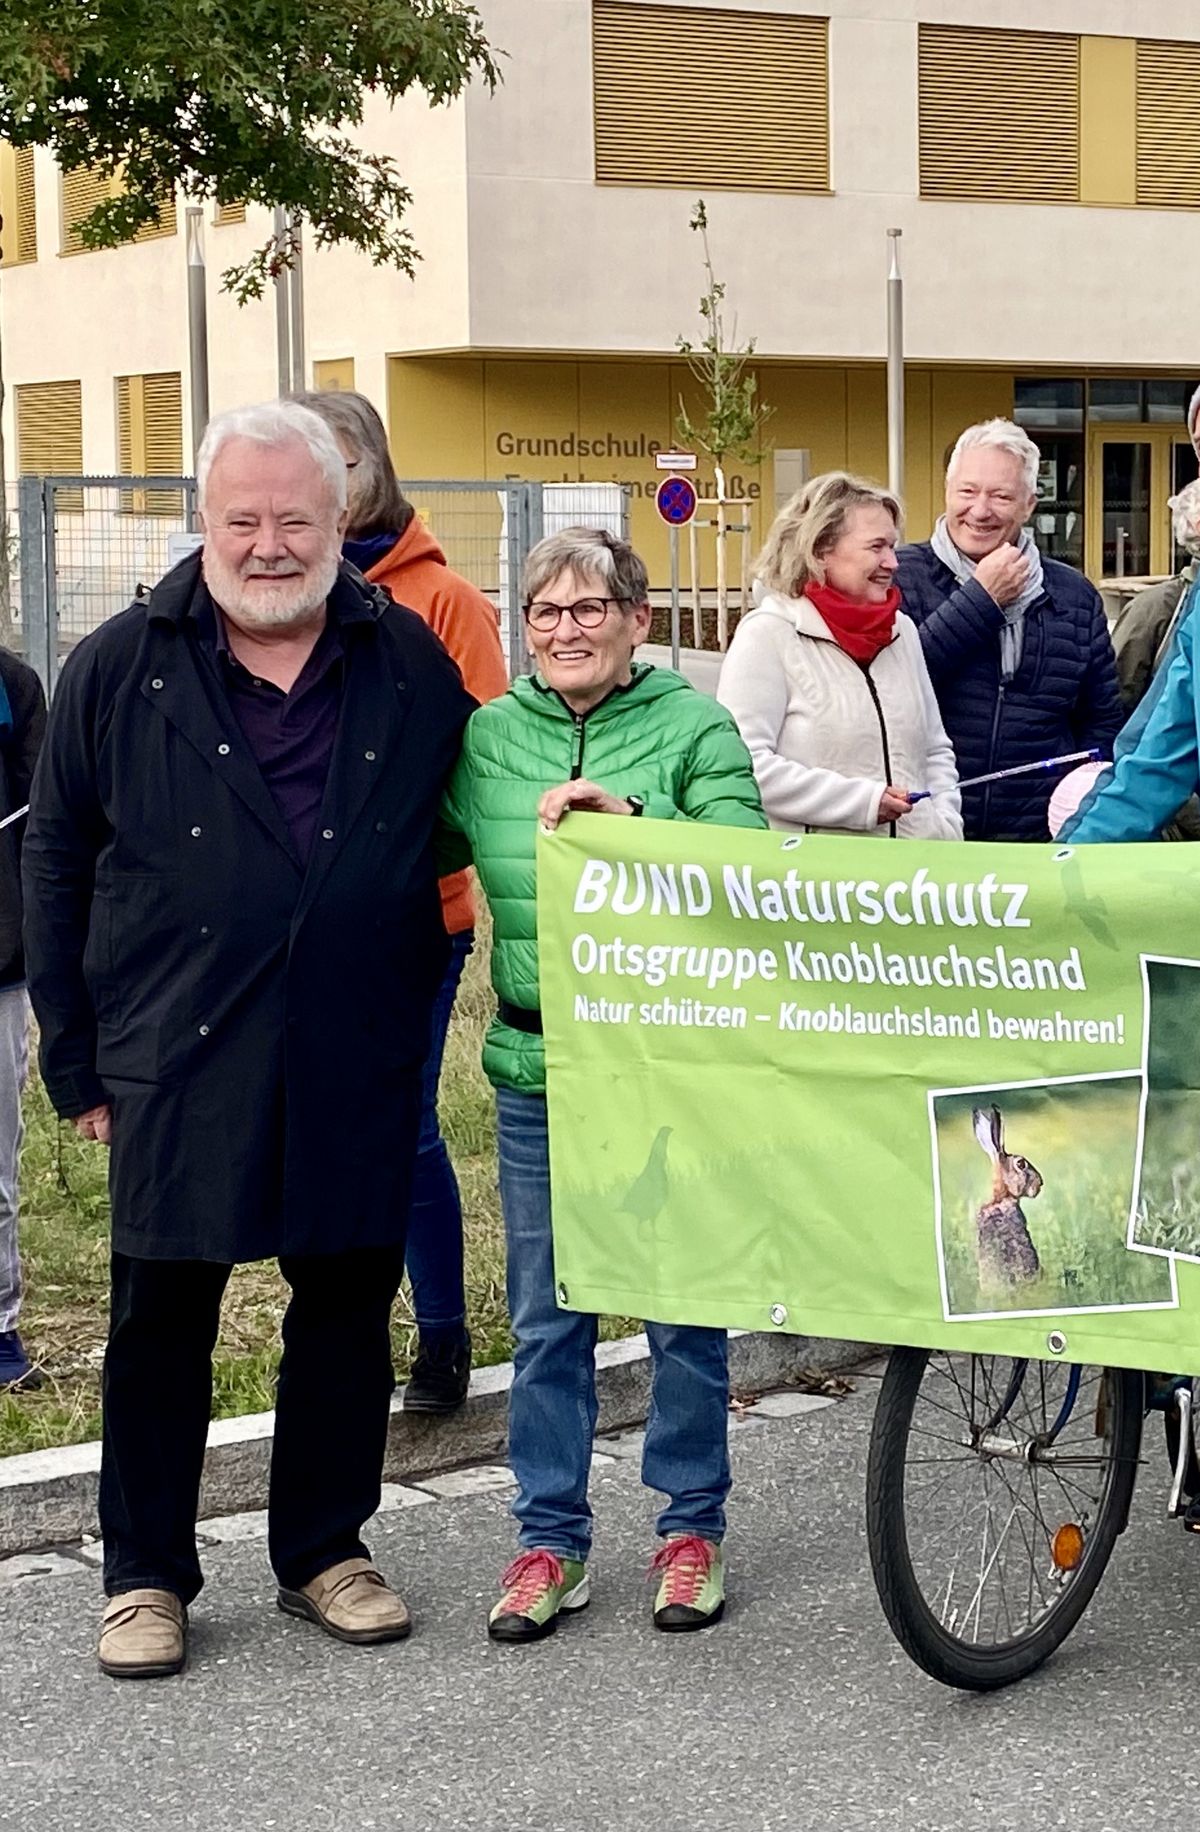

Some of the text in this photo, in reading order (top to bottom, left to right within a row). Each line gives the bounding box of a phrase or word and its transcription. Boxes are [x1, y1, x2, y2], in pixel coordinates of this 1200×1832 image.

[496, 431, 661, 458] Grundschule
[574, 859, 1030, 927] BUND Naturschutz
[572, 934, 1086, 990] Ortsgruppe Knoblauchsland
[574, 994, 633, 1024] Natur
[639, 997, 747, 1029] schützen
[779, 1002, 980, 1039] Knoblauchsland
[987, 1008, 1125, 1045] bewahren!
